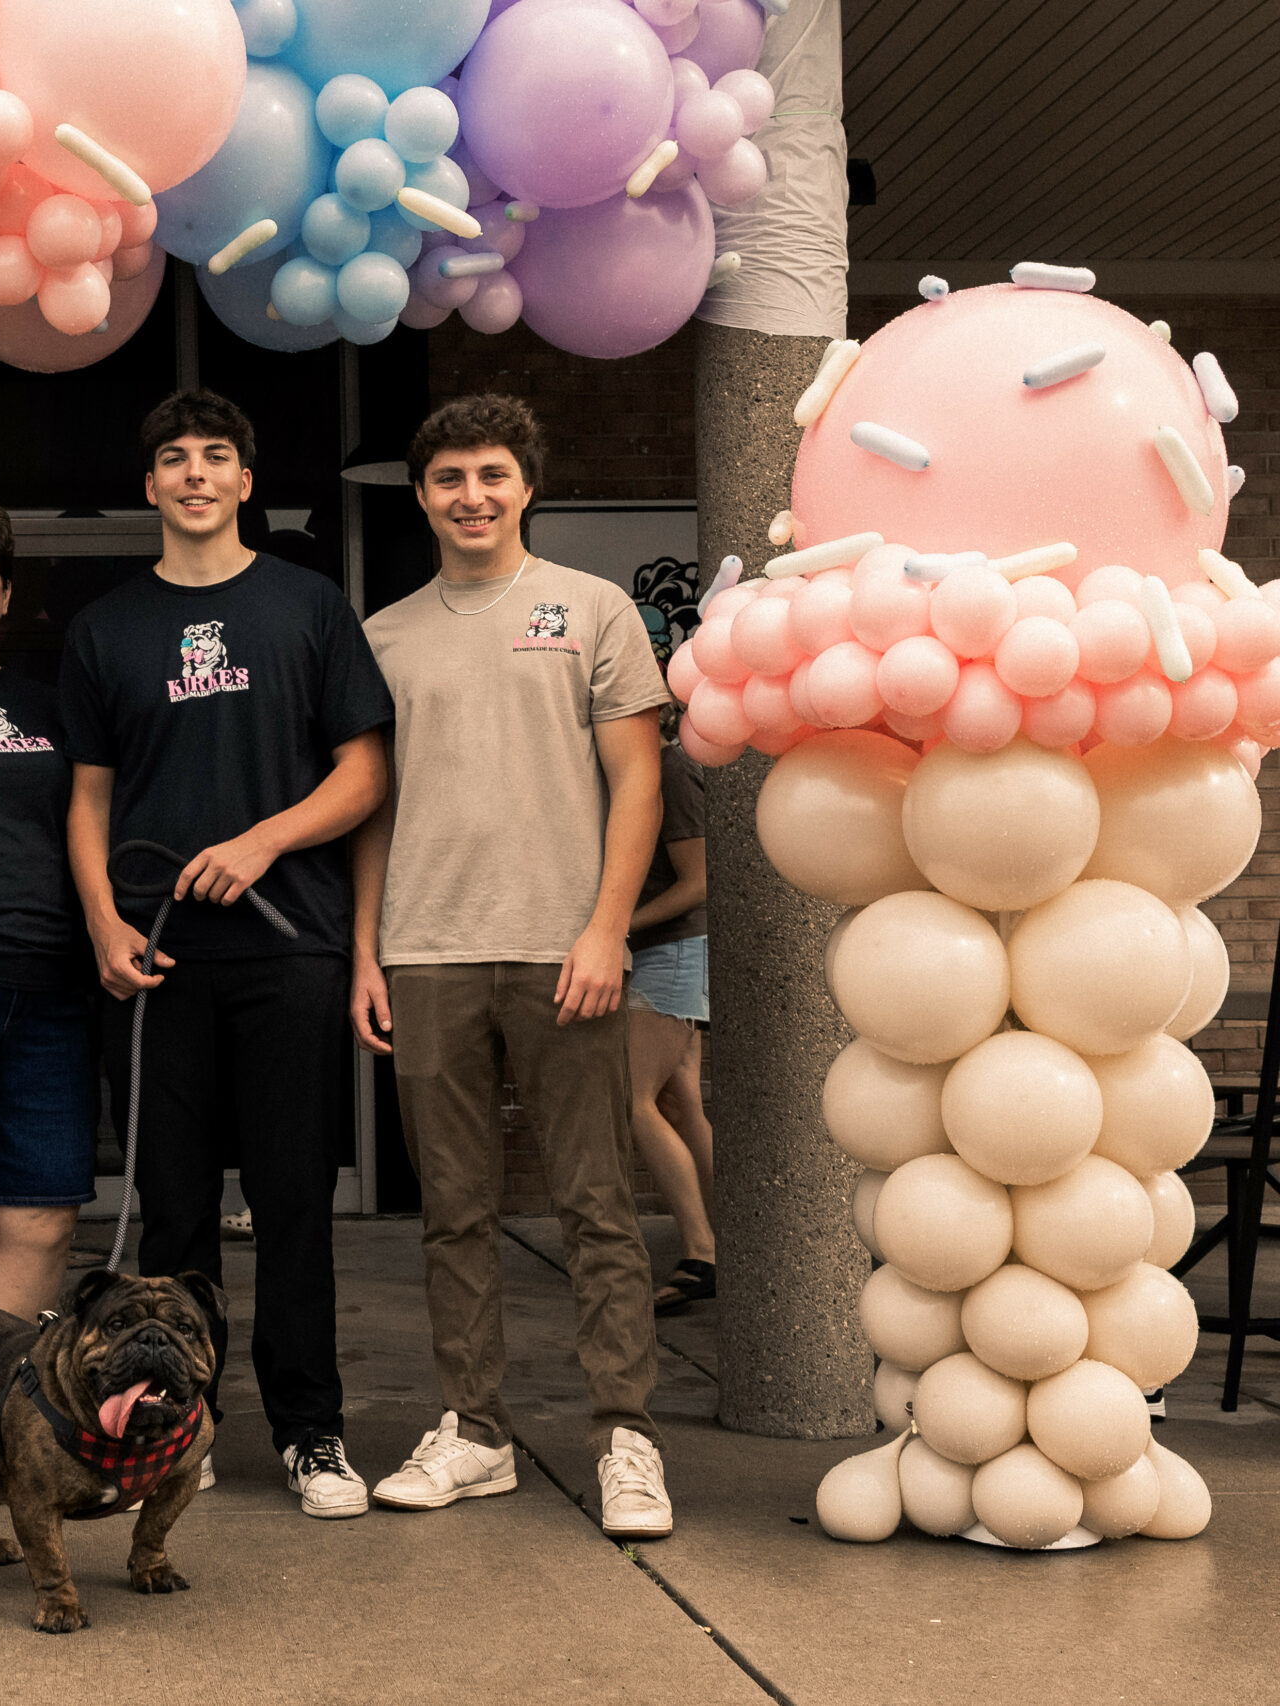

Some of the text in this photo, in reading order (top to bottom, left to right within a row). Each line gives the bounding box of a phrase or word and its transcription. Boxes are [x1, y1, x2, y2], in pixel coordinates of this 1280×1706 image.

[166, 666, 249, 696] KIRKE'S
[170, 683, 249, 702] HOMEMADE ICE CREAM
